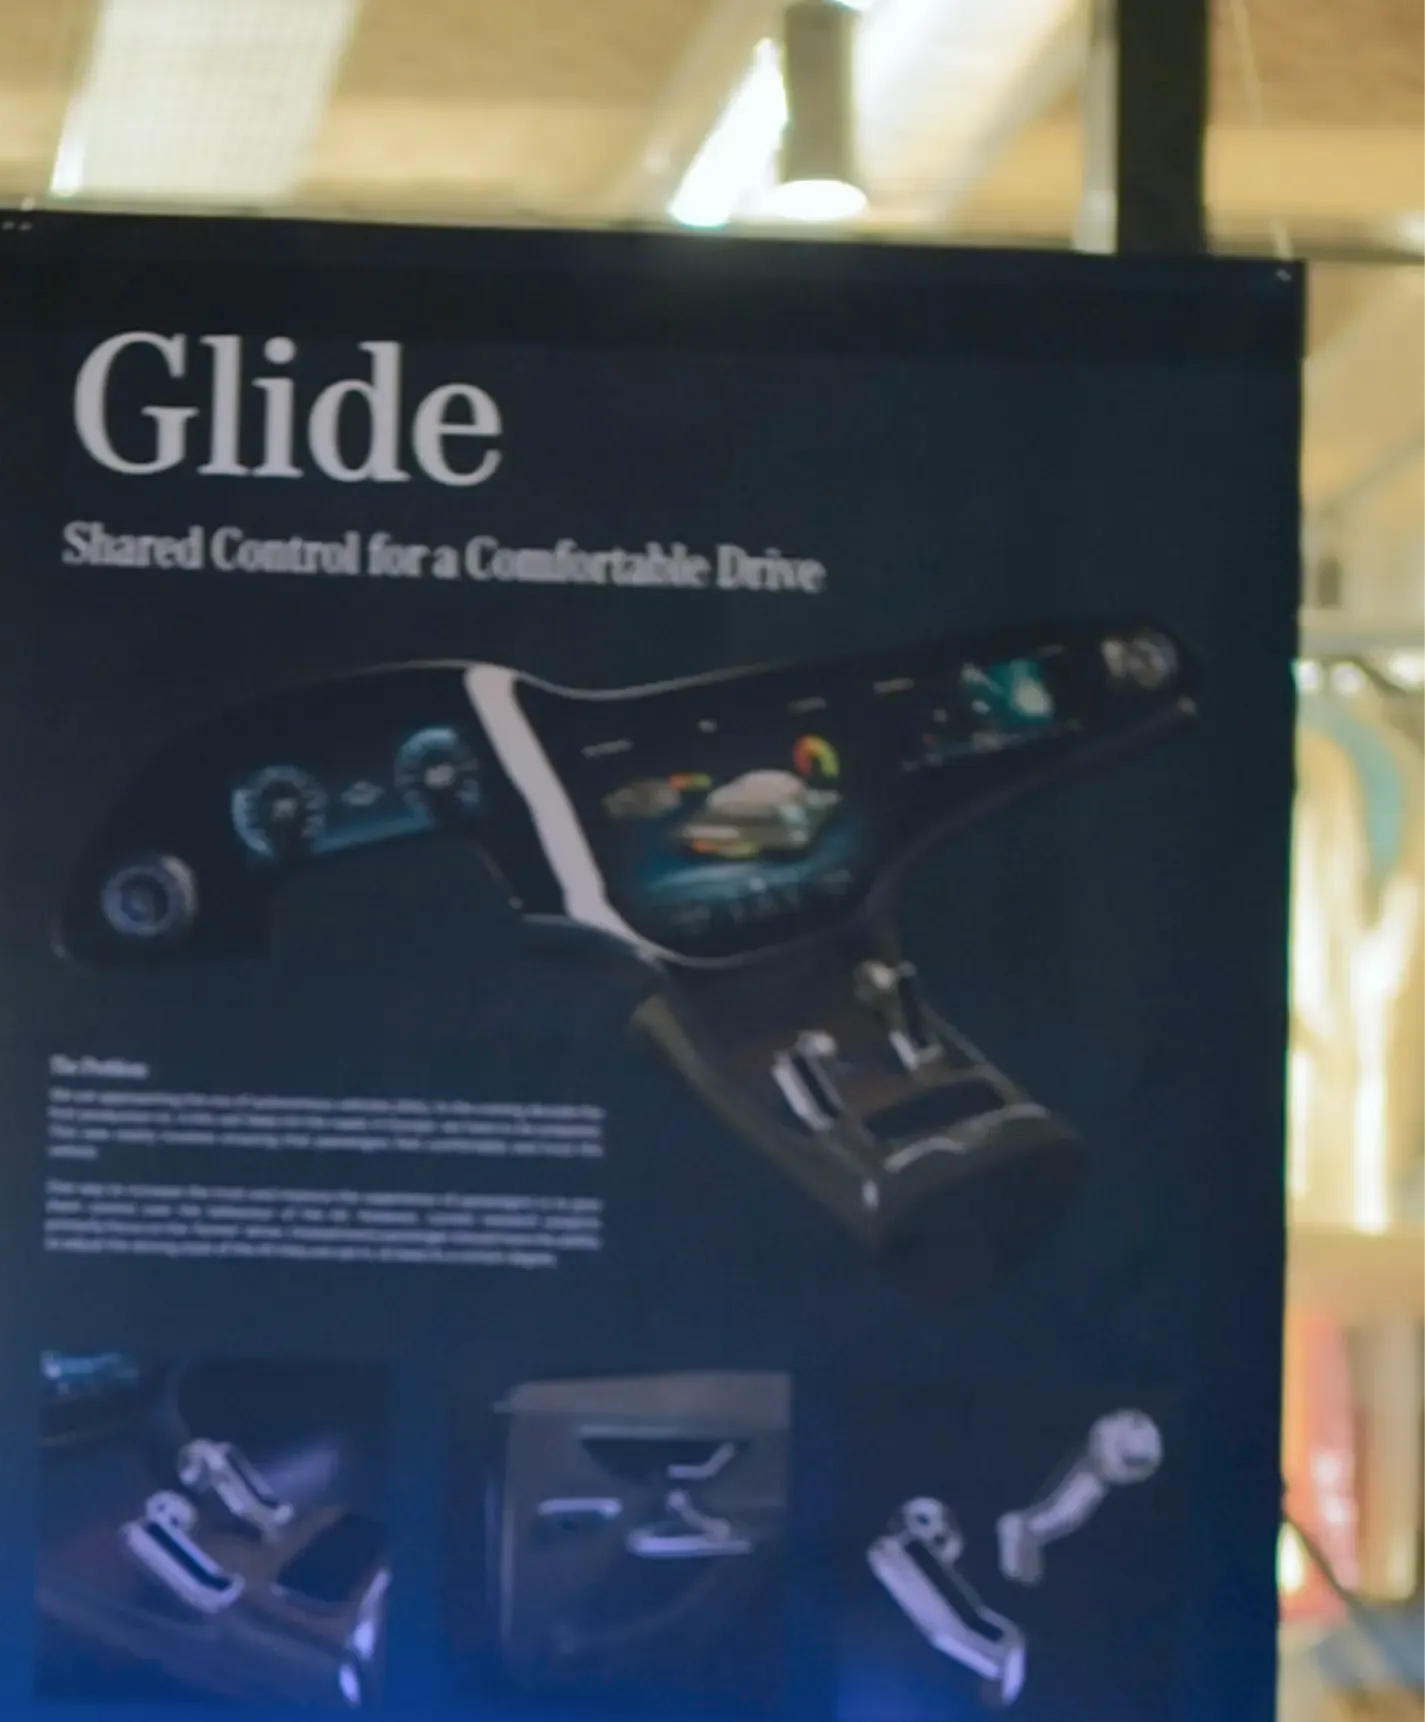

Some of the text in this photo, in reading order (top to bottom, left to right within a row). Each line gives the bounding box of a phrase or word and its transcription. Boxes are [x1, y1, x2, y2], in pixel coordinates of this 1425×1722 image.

[73, 331, 502, 486] Glide
[62, 520, 827, 593] Shared Control for a Comfortable Drive
